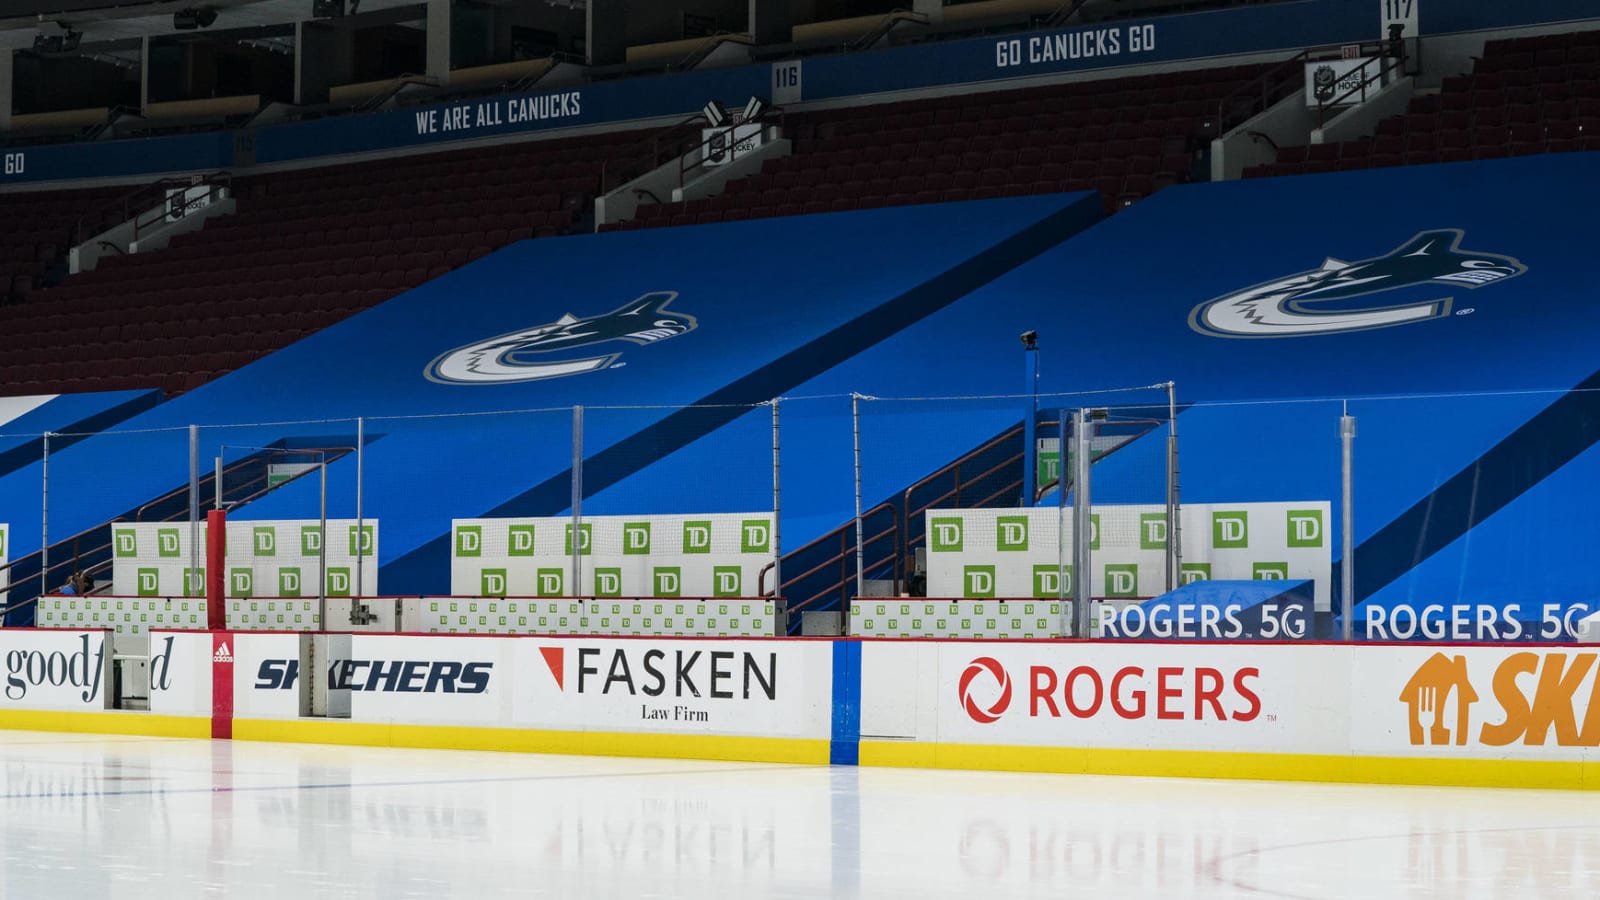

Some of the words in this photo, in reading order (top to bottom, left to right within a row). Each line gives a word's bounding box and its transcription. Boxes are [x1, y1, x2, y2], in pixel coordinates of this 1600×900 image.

[996, 39, 1021, 68] GO
[1029, 28, 1121, 64] CANUCKS
[1128, 24, 1154, 53] GO
[776, 67, 797, 88] 116
[416, 109, 437, 135] WE
[442, 105, 471, 132] ARE
[476, 102, 502, 127] ALL
[508, 91, 581, 123] CANUCKS
[5, 152, 24, 174] GO
[626, 528, 648, 549] TD
[686, 526, 708, 547] TD
[744, 525, 767, 547] TD
[934, 524, 960, 545] TD
[1000, 522, 1026, 545] TD
[1216, 518, 1245, 541] TD
[1290, 516, 1319, 540] TD
[118, 534, 135, 552] TD
[159, 533, 177, 552] TD
[256, 532, 273, 550] TD
[458, 531, 479, 551] TD
[511, 530, 532, 550] TD
[139, 573, 157, 591] TD
[233, 573, 250, 591] TD
[281, 573, 299, 591] TD
[329, 573, 348, 591] TD
[483, 574, 504, 594] TD
[539, 573, 561, 593] TD
[597, 573, 619, 593] TD
[656, 572, 678, 593] TD
[716, 572, 739, 593] TD
[967, 571, 993, 594] TD
[1108, 571, 1135, 593] TD
[1099, 604, 1243, 638] ROGERS
[1260, 604, 1306, 638] 5G
[1366, 603, 1523, 640] ROGERS
[5, 633, 175, 703] goodfd
[577, 648, 776, 700] FASKEN
[1030, 665, 1261, 722] ROGERS
[641, 704, 670, 720] Law
[675, 705, 709, 722] Firm
